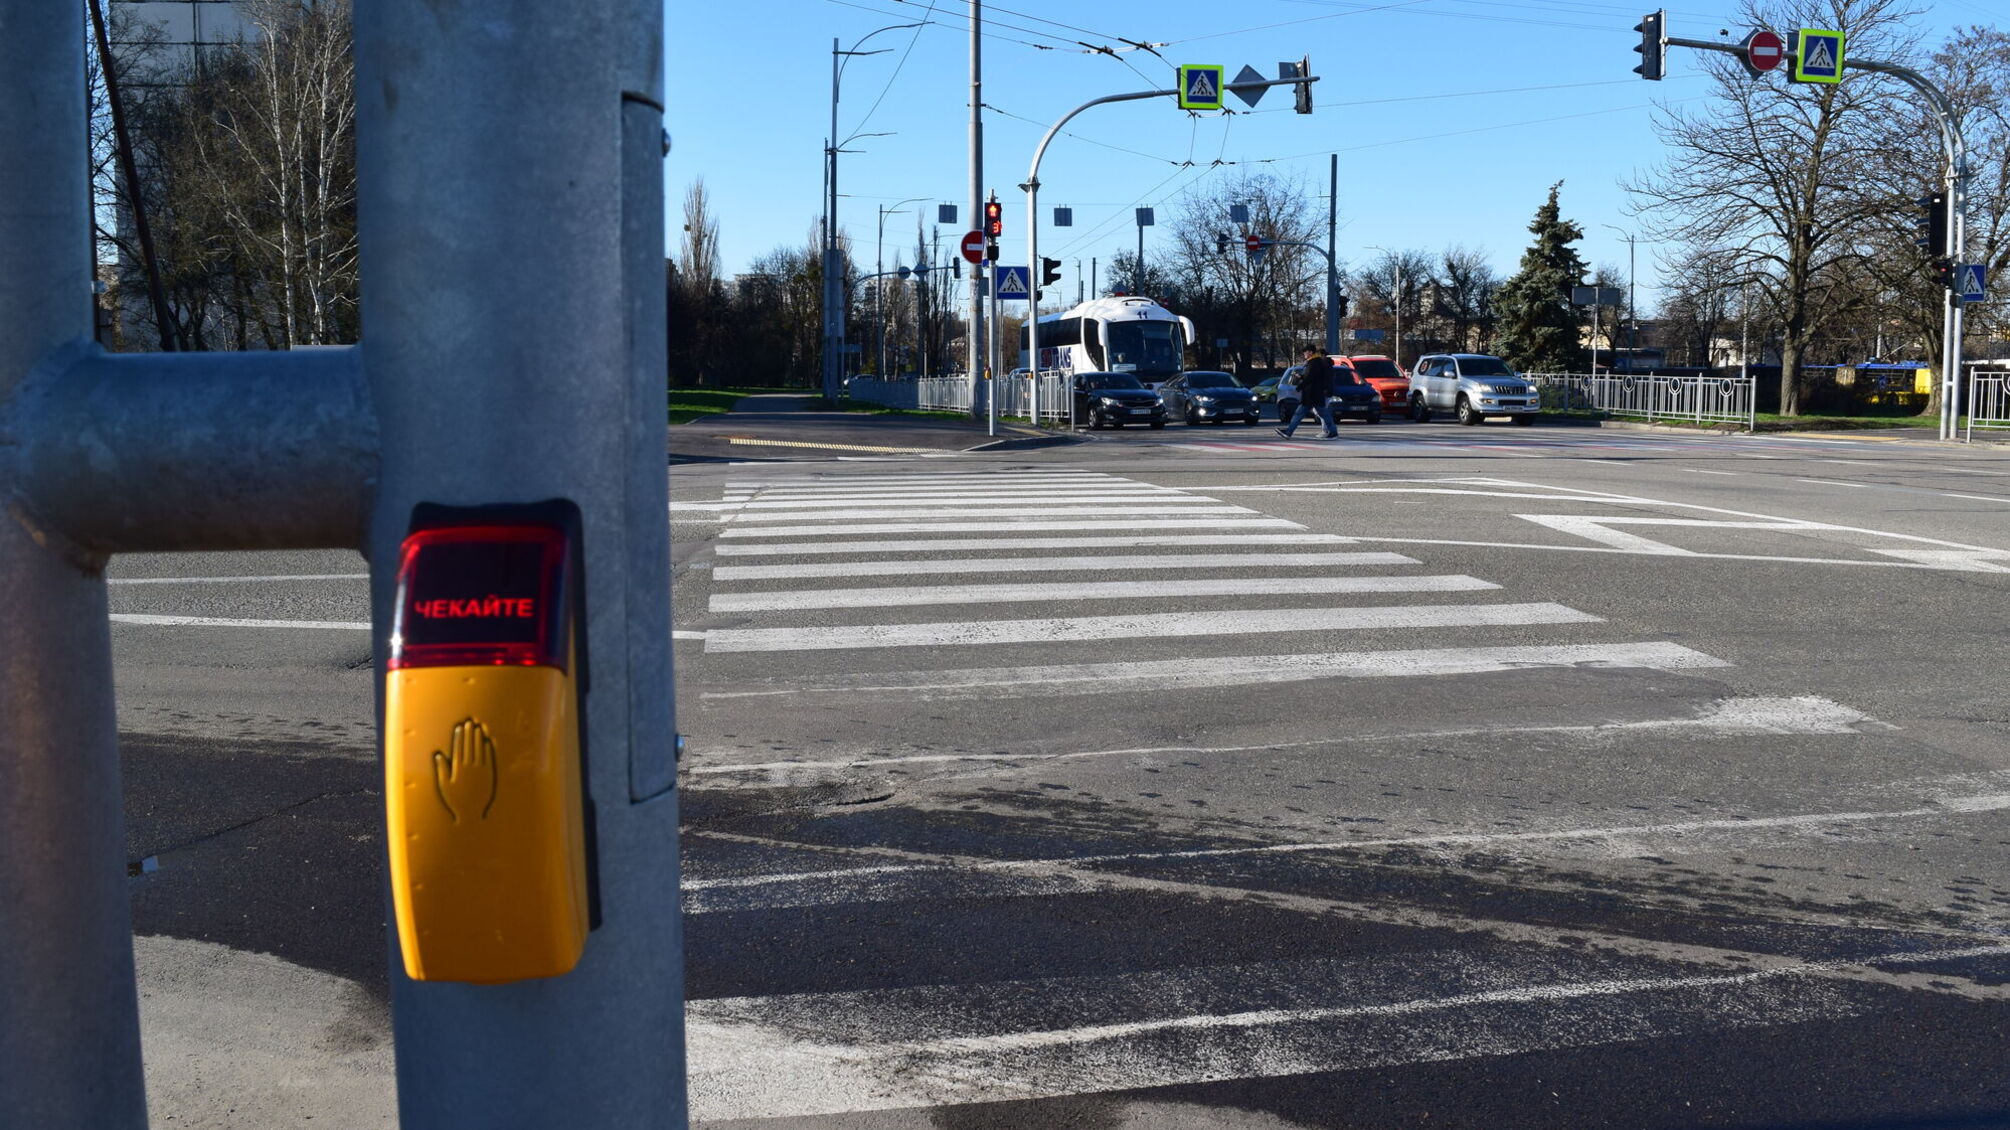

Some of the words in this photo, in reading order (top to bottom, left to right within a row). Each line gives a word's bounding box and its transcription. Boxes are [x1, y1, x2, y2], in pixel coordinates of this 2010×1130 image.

[993, 222, 999, 233] 3
[1137, 311, 1148, 319] 11
[414, 595, 534, 618] ЧЕКАЙТЕ
